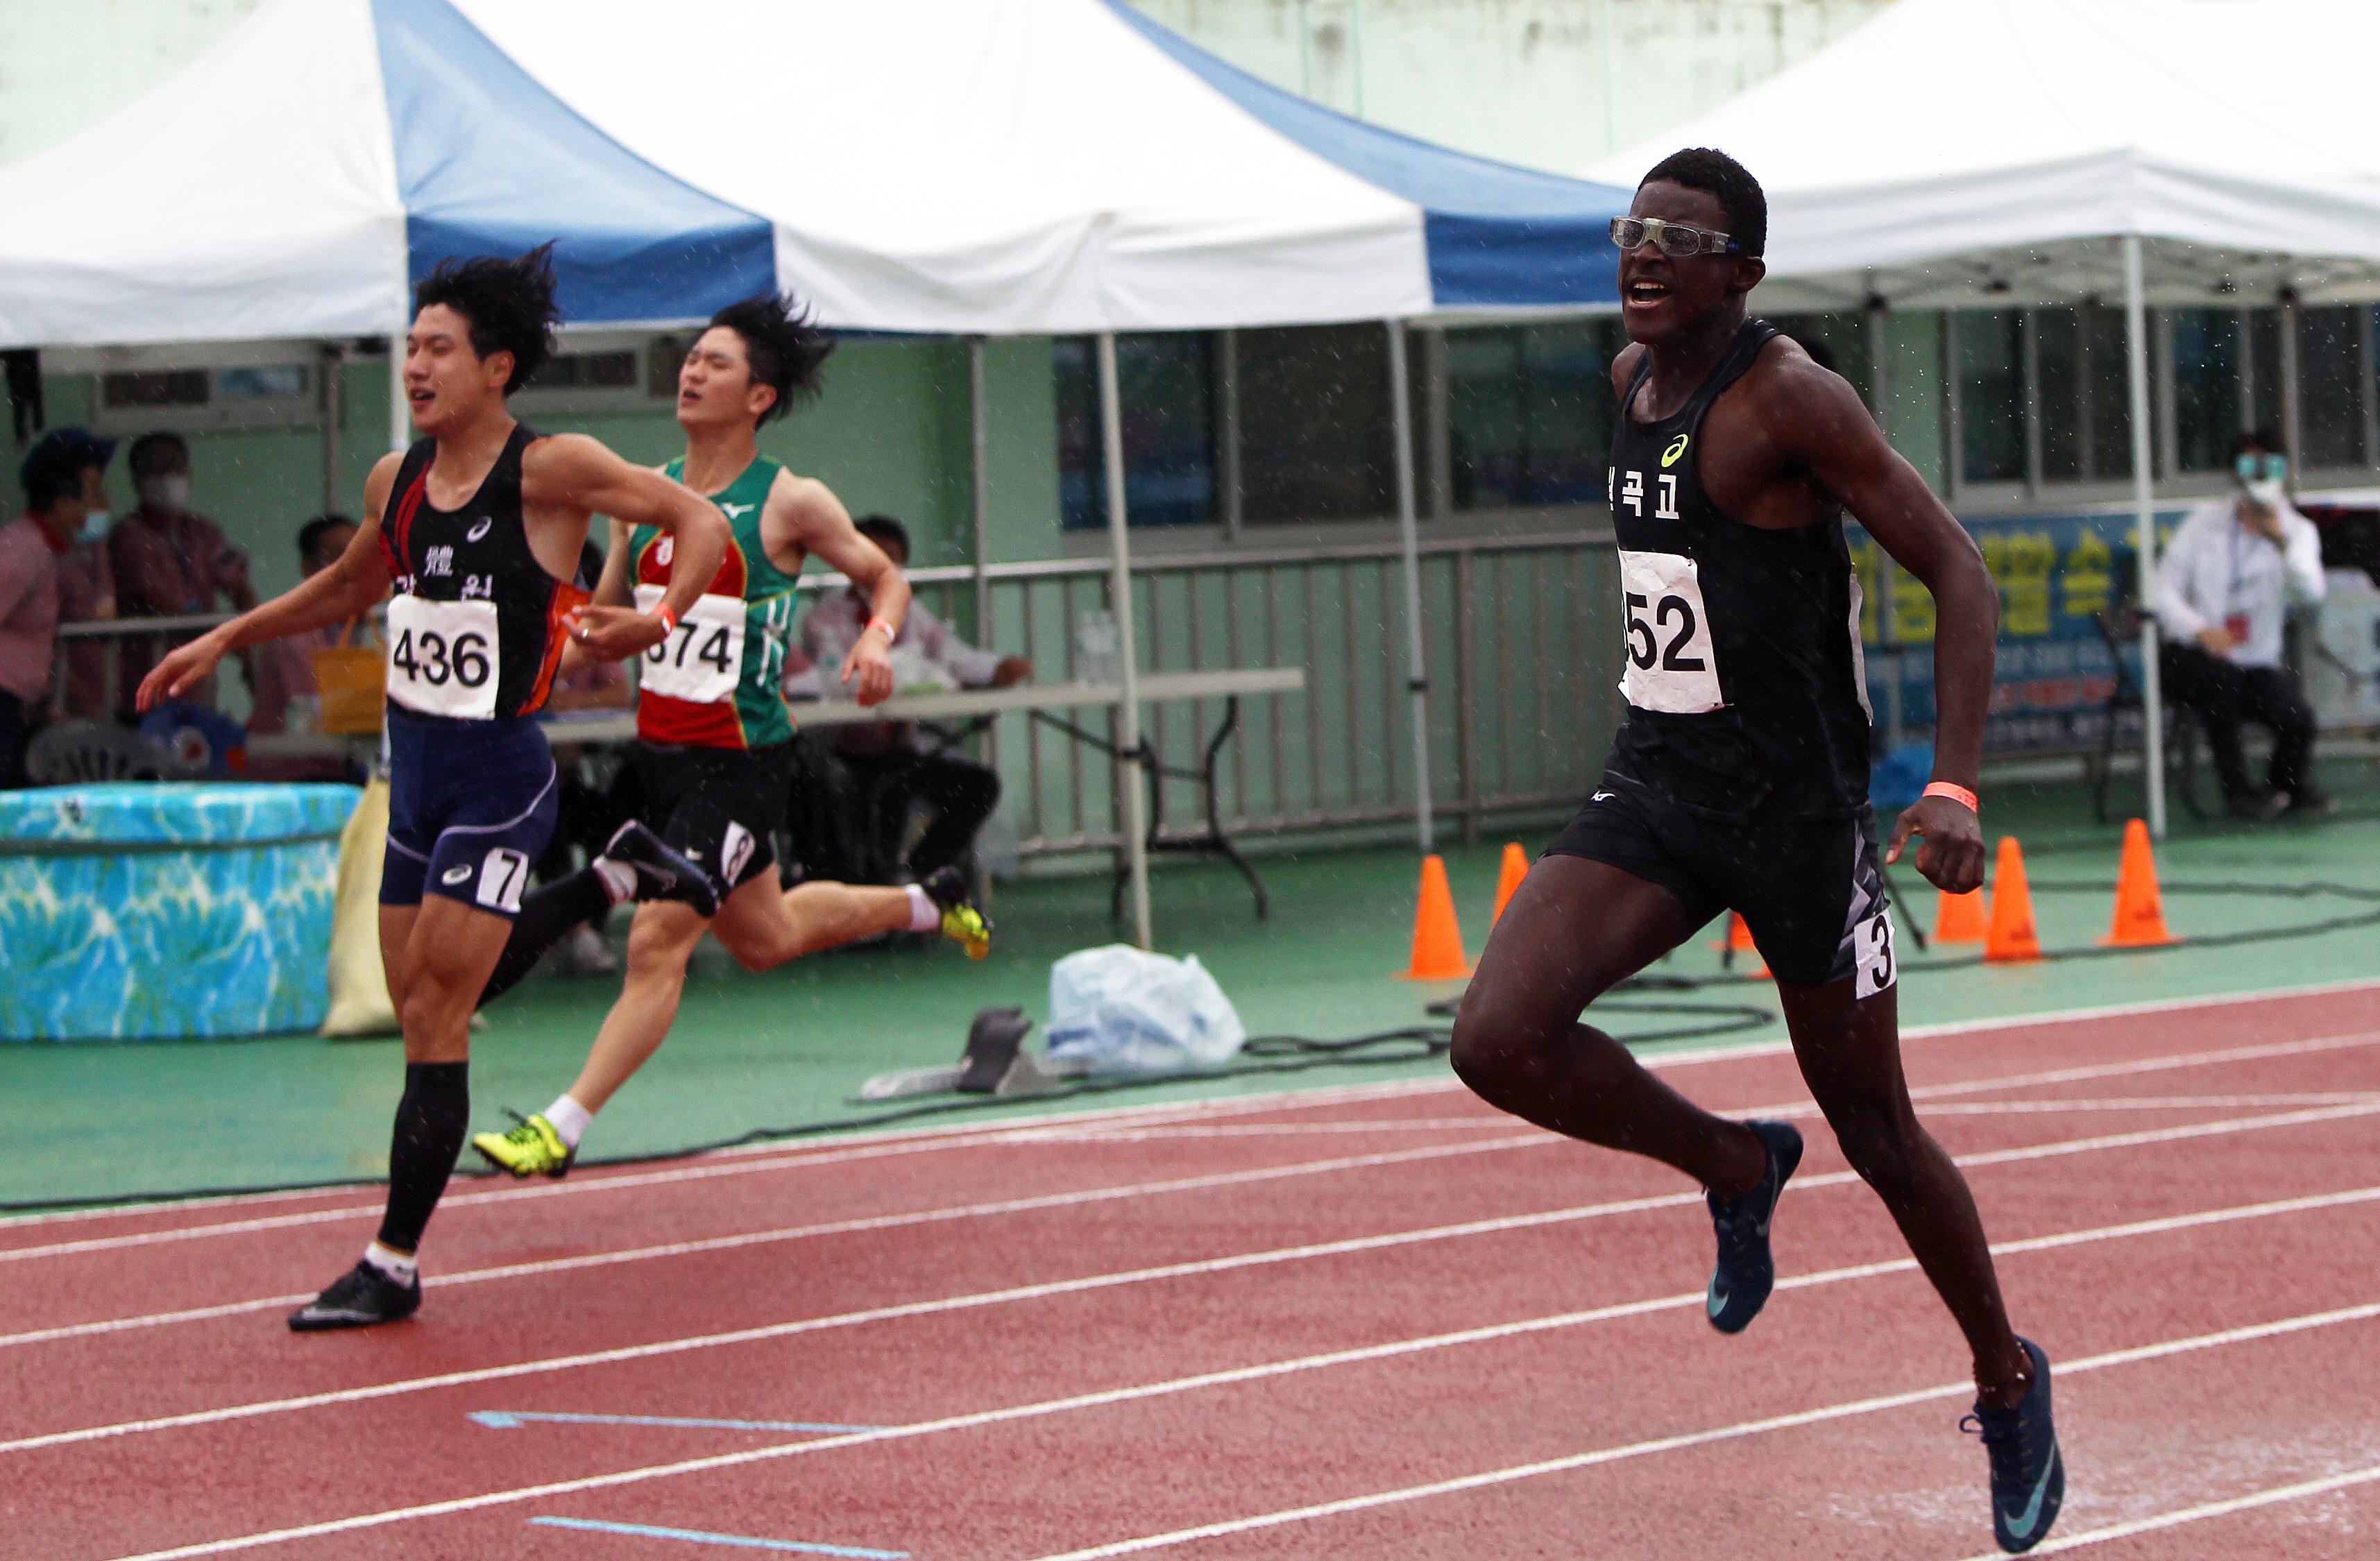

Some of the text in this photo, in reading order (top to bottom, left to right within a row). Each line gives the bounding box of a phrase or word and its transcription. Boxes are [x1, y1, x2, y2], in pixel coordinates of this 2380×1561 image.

[393, 627, 491, 688] 436
[1626, 591, 1707, 672] 52
[496, 853, 520, 904] 7
[1871, 914, 1892, 989] 3
